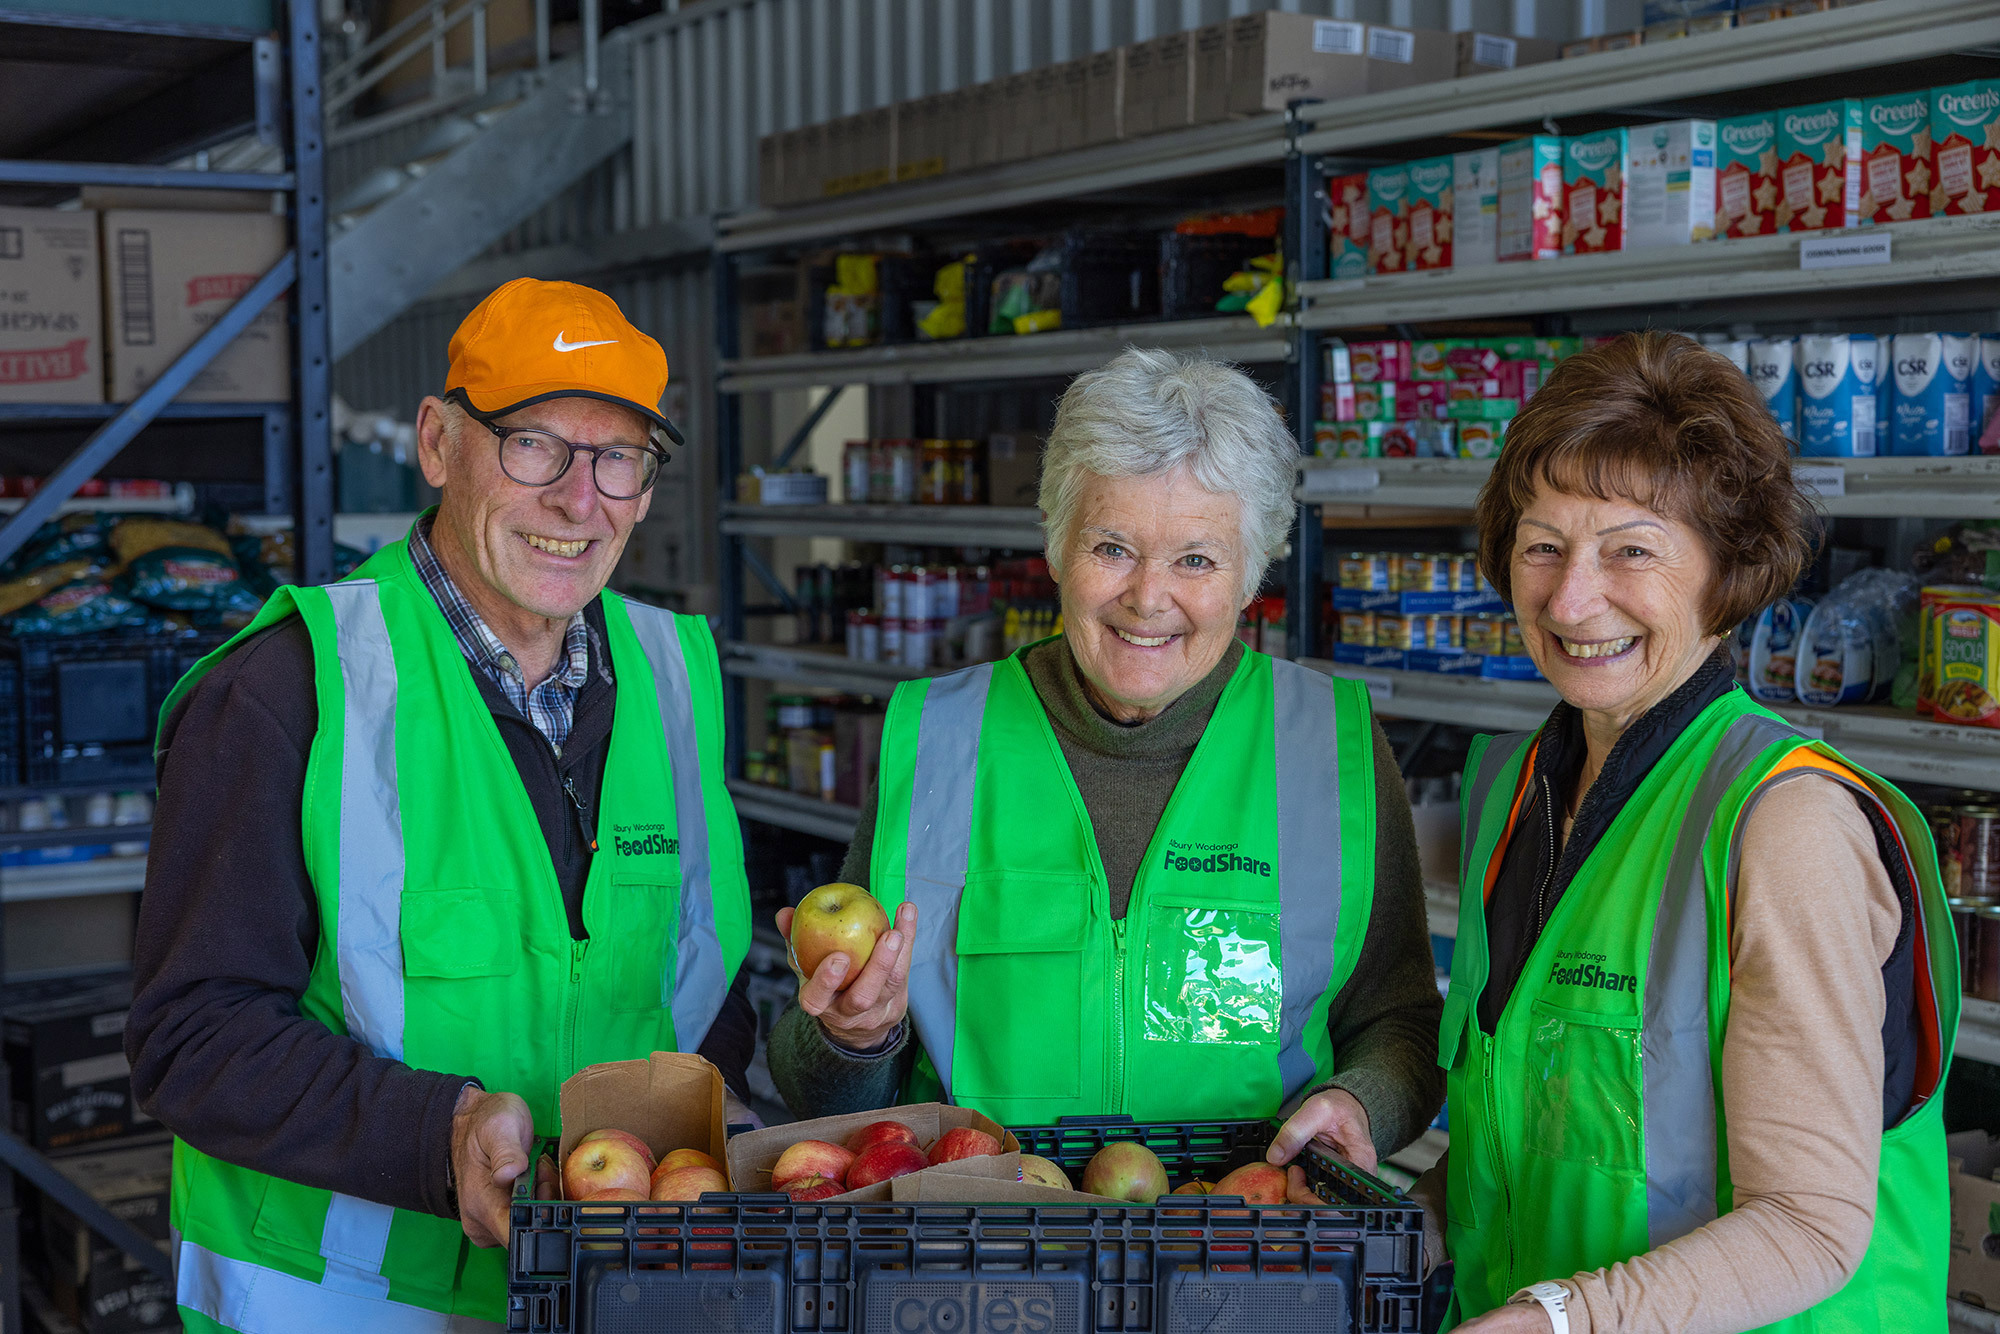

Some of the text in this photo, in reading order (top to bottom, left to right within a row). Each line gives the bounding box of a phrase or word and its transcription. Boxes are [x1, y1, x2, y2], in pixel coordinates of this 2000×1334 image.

[1870, 98, 1928, 125] Green's
[1938, 87, 1999, 116] Green's
[1722, 120, 1775, 144] Green's
[1784, 109, 1840, 135] Green's
[1805, 361, 1836, 379] CSR
[1898, 357, 1928, 377] CSR
[1943, 638, 1984, 662] SEMOLA
[633, 823, 665, 833] Wodonga
[1195, 842, 1239, 852] Wodonga
[1164, 850, 1271, 877] FoodShare
[1548, 962, 1637, 994] FoodShare
[893, 1285, 1053, 1334] coles
